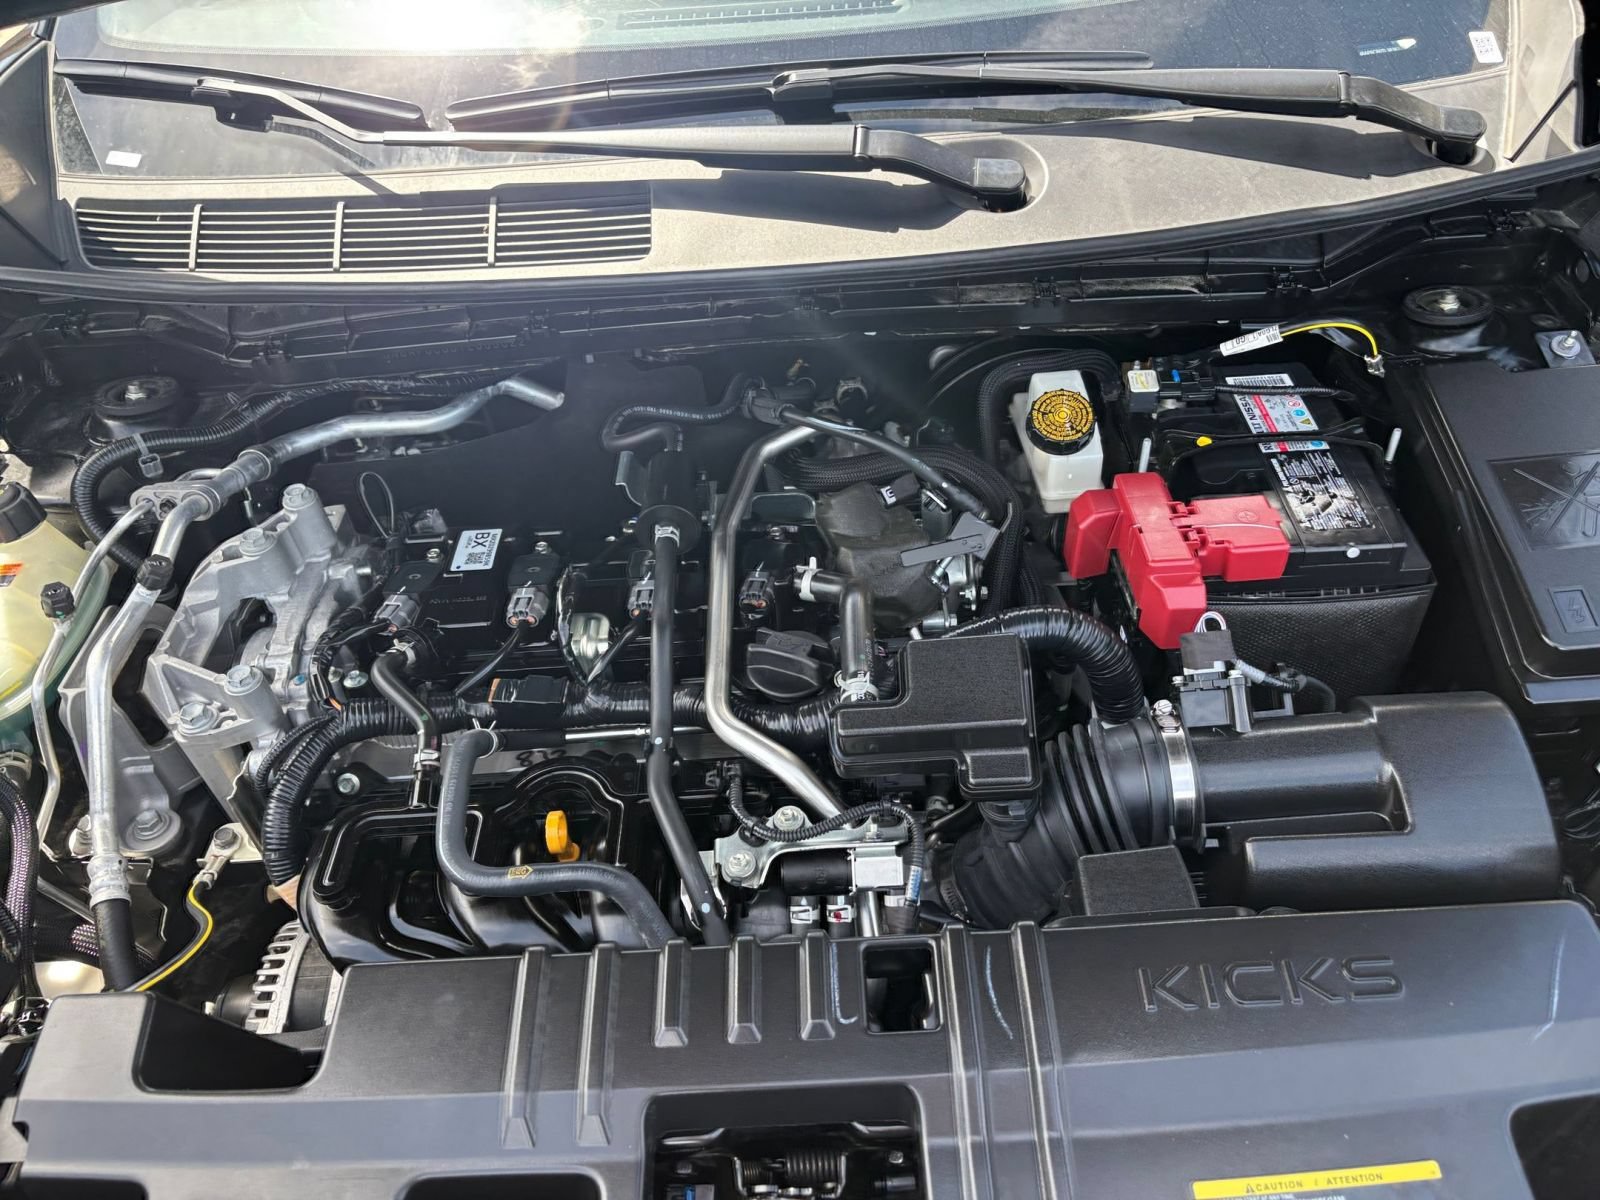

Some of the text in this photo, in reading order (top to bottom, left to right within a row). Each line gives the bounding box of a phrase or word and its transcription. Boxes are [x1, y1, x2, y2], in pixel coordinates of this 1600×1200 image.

[473, 531, 491, 549] BX
[1137, 954, 1405, 1012] KICKS
[1256, 1180, 1303, 1192] CAUTION
[1326, 1173, 1383, 1186] ATTENTION
